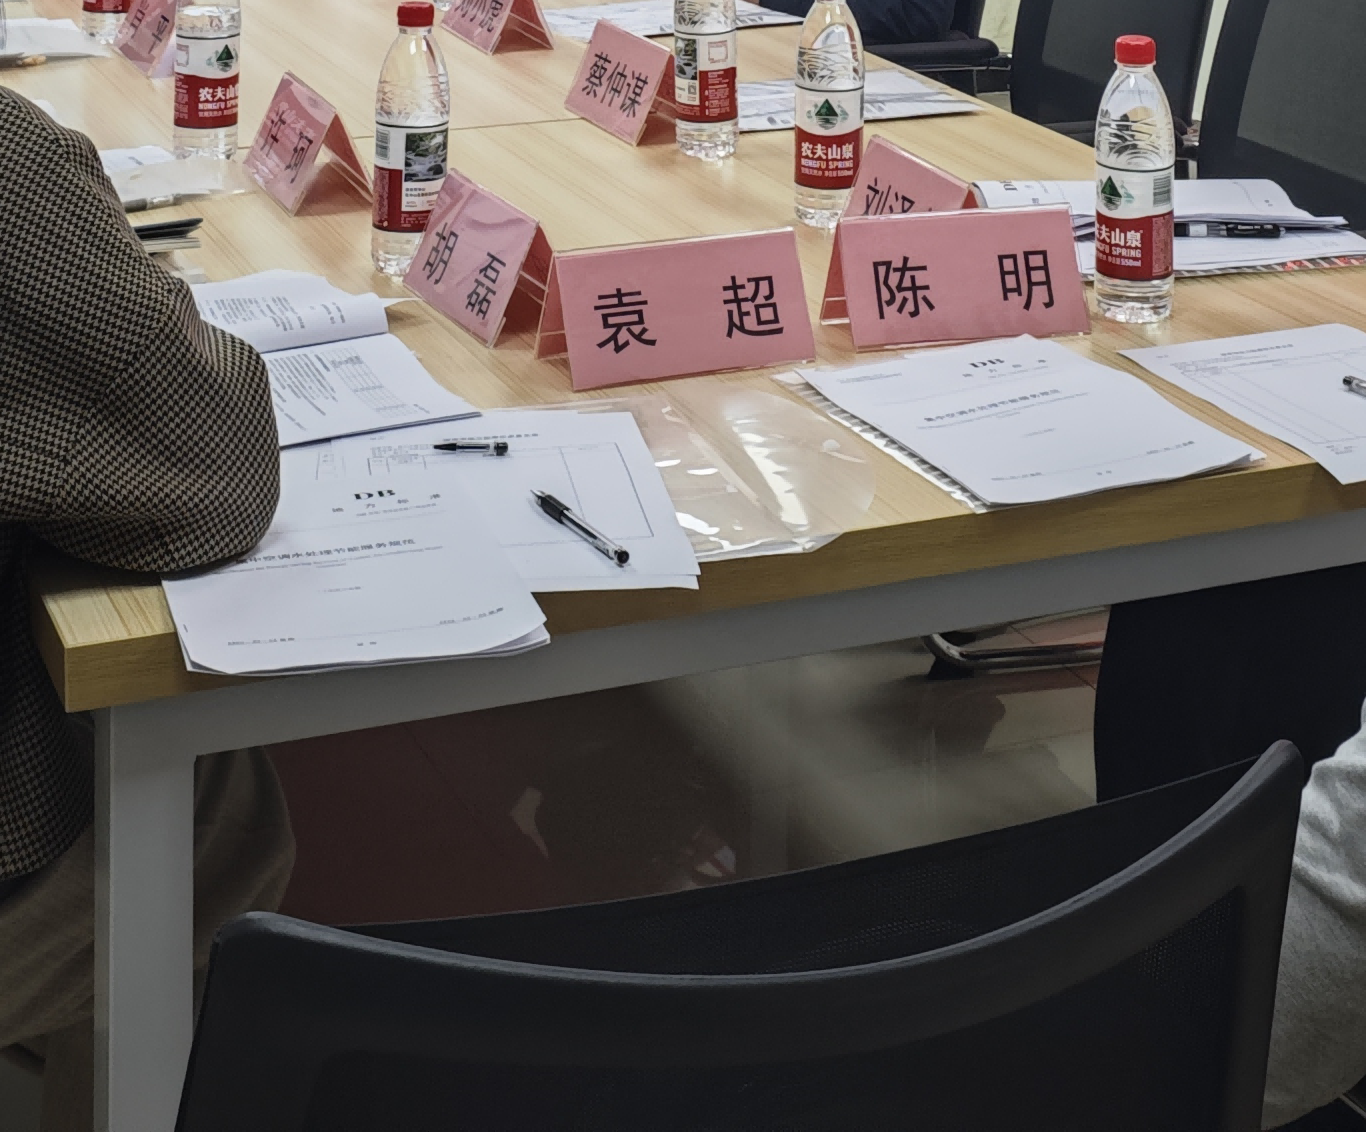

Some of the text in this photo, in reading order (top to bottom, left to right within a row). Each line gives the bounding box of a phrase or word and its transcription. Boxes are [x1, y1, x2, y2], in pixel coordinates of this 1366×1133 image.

[582, 52, 649, 118] 蔡仲谋
[801, 141, 854, 159] 农夫山泉
[422, 223, 507, 320] 胡磊
[873, 249, 1055, 320] 陈明
[1112, 246, 1142, 258] SPRING
[594, 275, 784, 354] 袁超
[354, 489, 396, 500] DB
